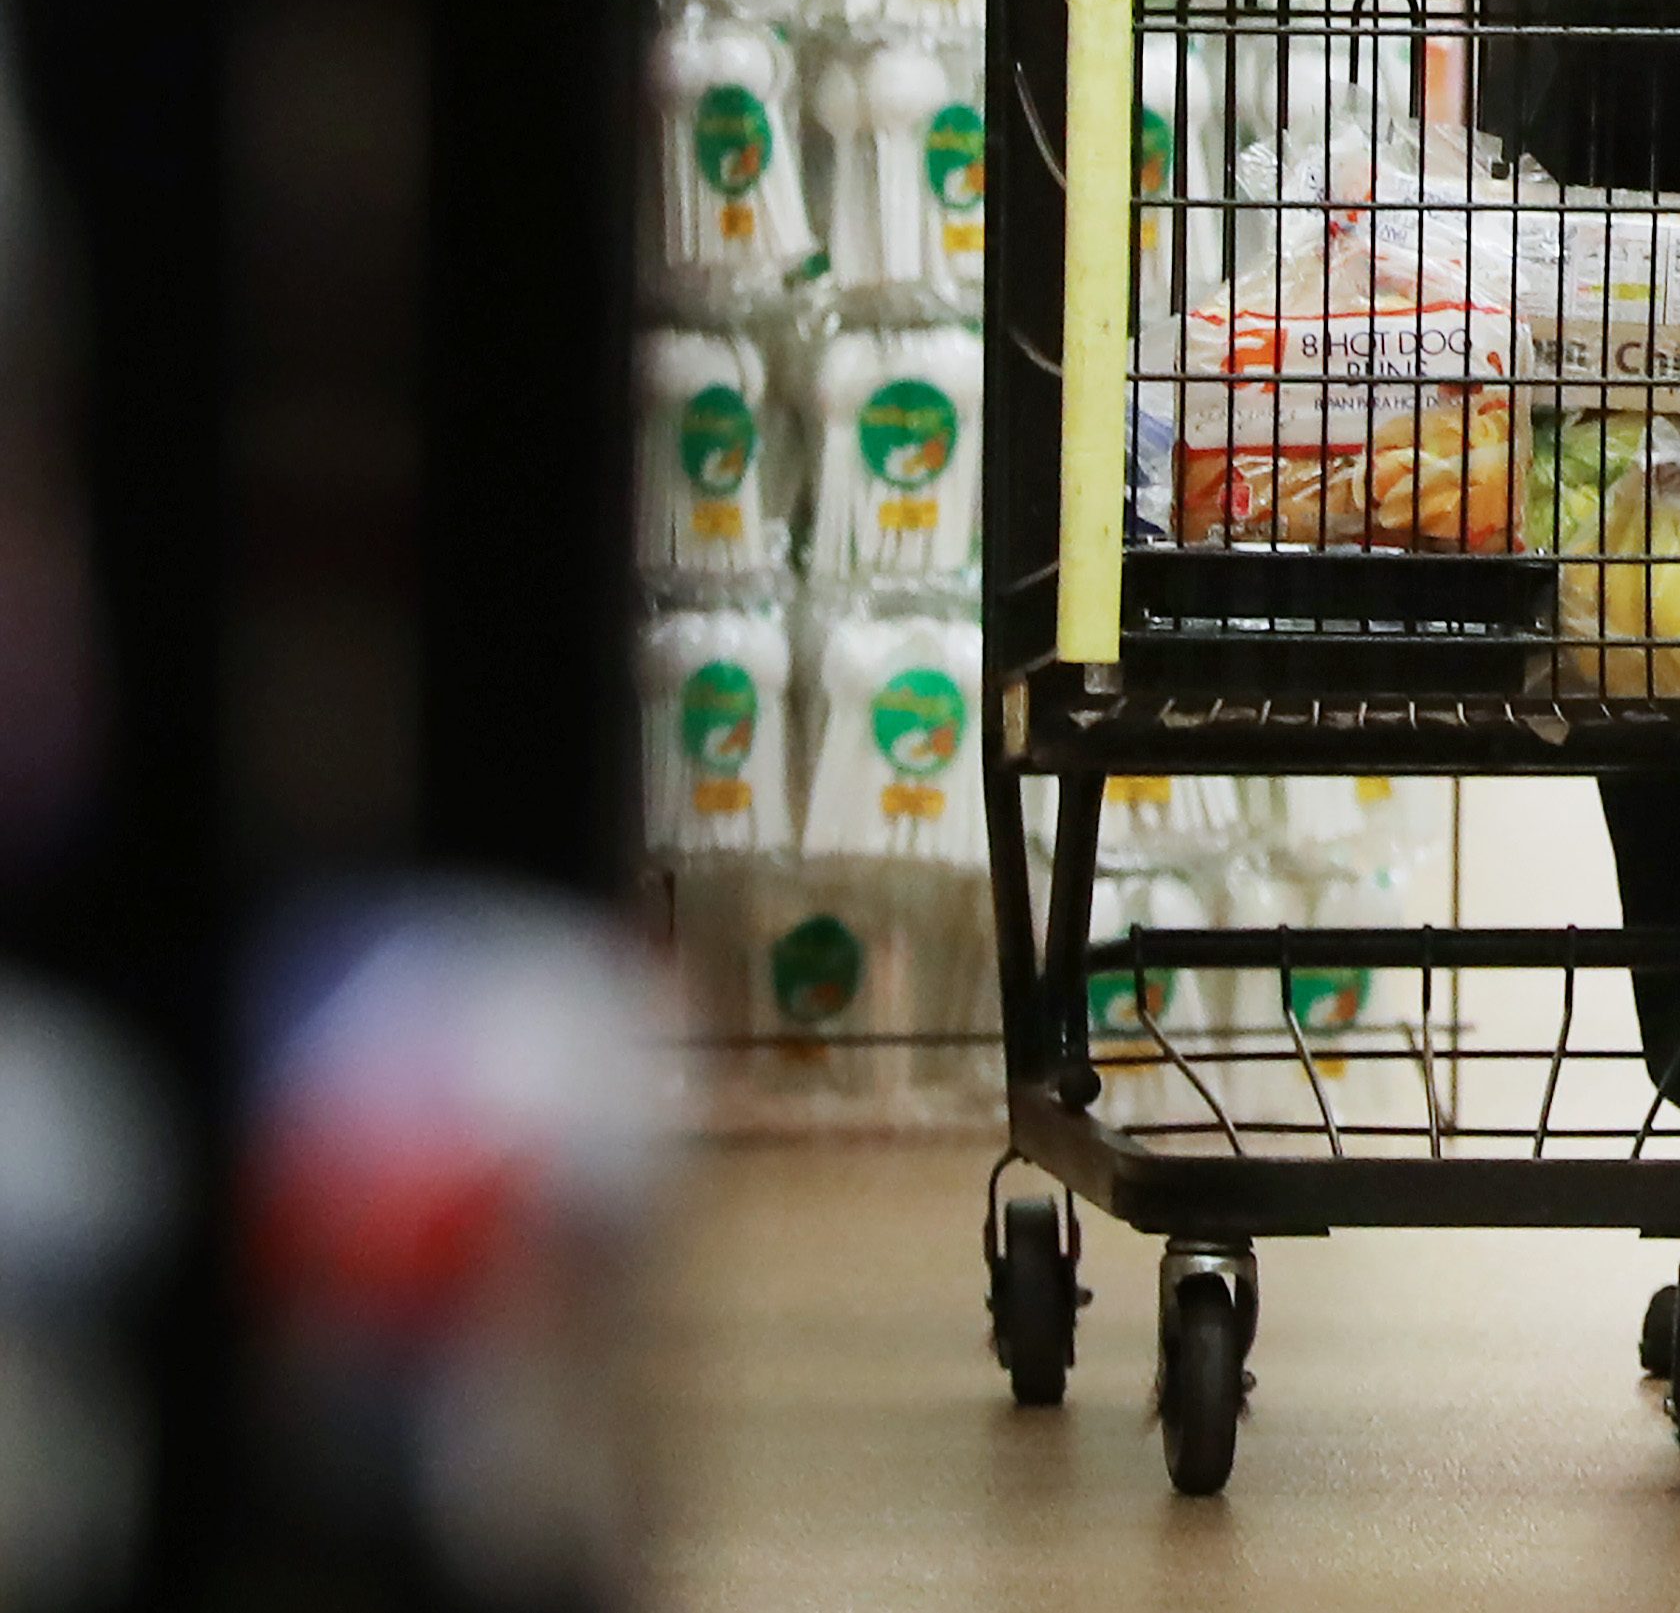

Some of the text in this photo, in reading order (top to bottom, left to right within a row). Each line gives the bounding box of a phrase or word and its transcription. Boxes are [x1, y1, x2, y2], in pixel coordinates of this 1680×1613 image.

[1301, 327, 1472, 358] 8 HOT DOG
